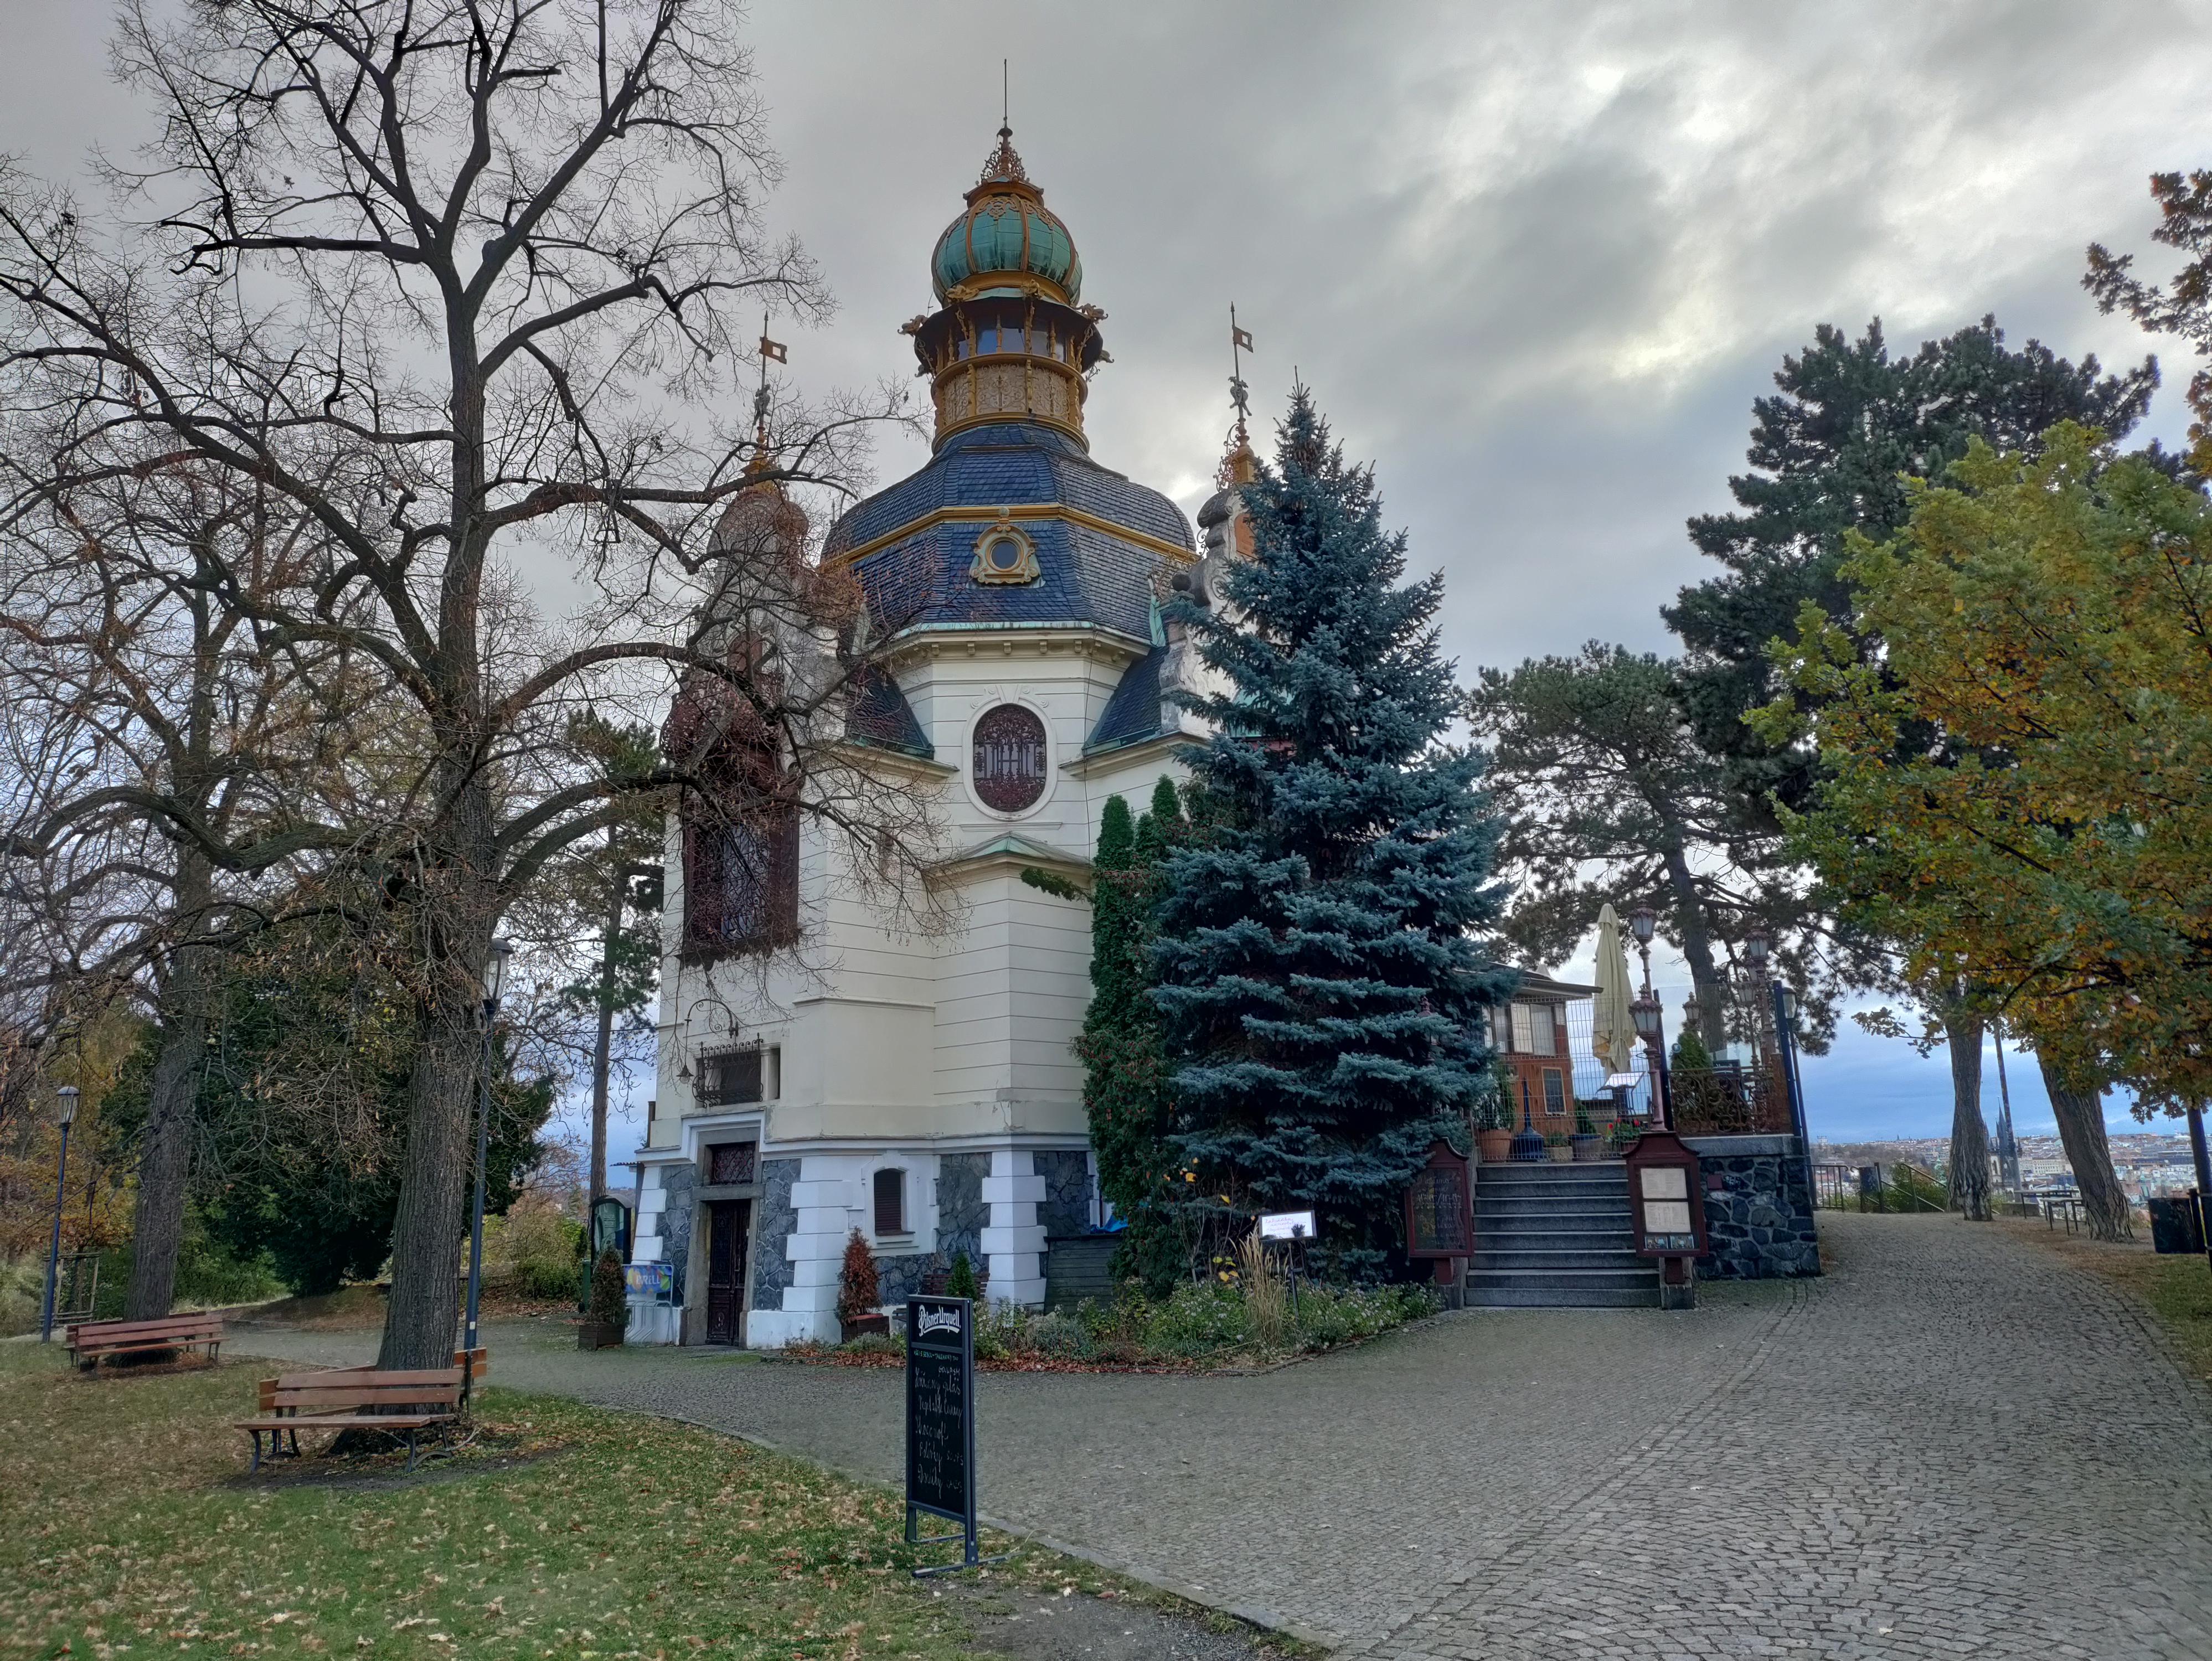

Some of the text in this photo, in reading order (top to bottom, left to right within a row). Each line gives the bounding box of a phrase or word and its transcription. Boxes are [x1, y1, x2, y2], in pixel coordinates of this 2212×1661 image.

[636, 1275, 661, 1285] BIRELL
[918, 1304, 960, 1337] Pilsner Urquell
